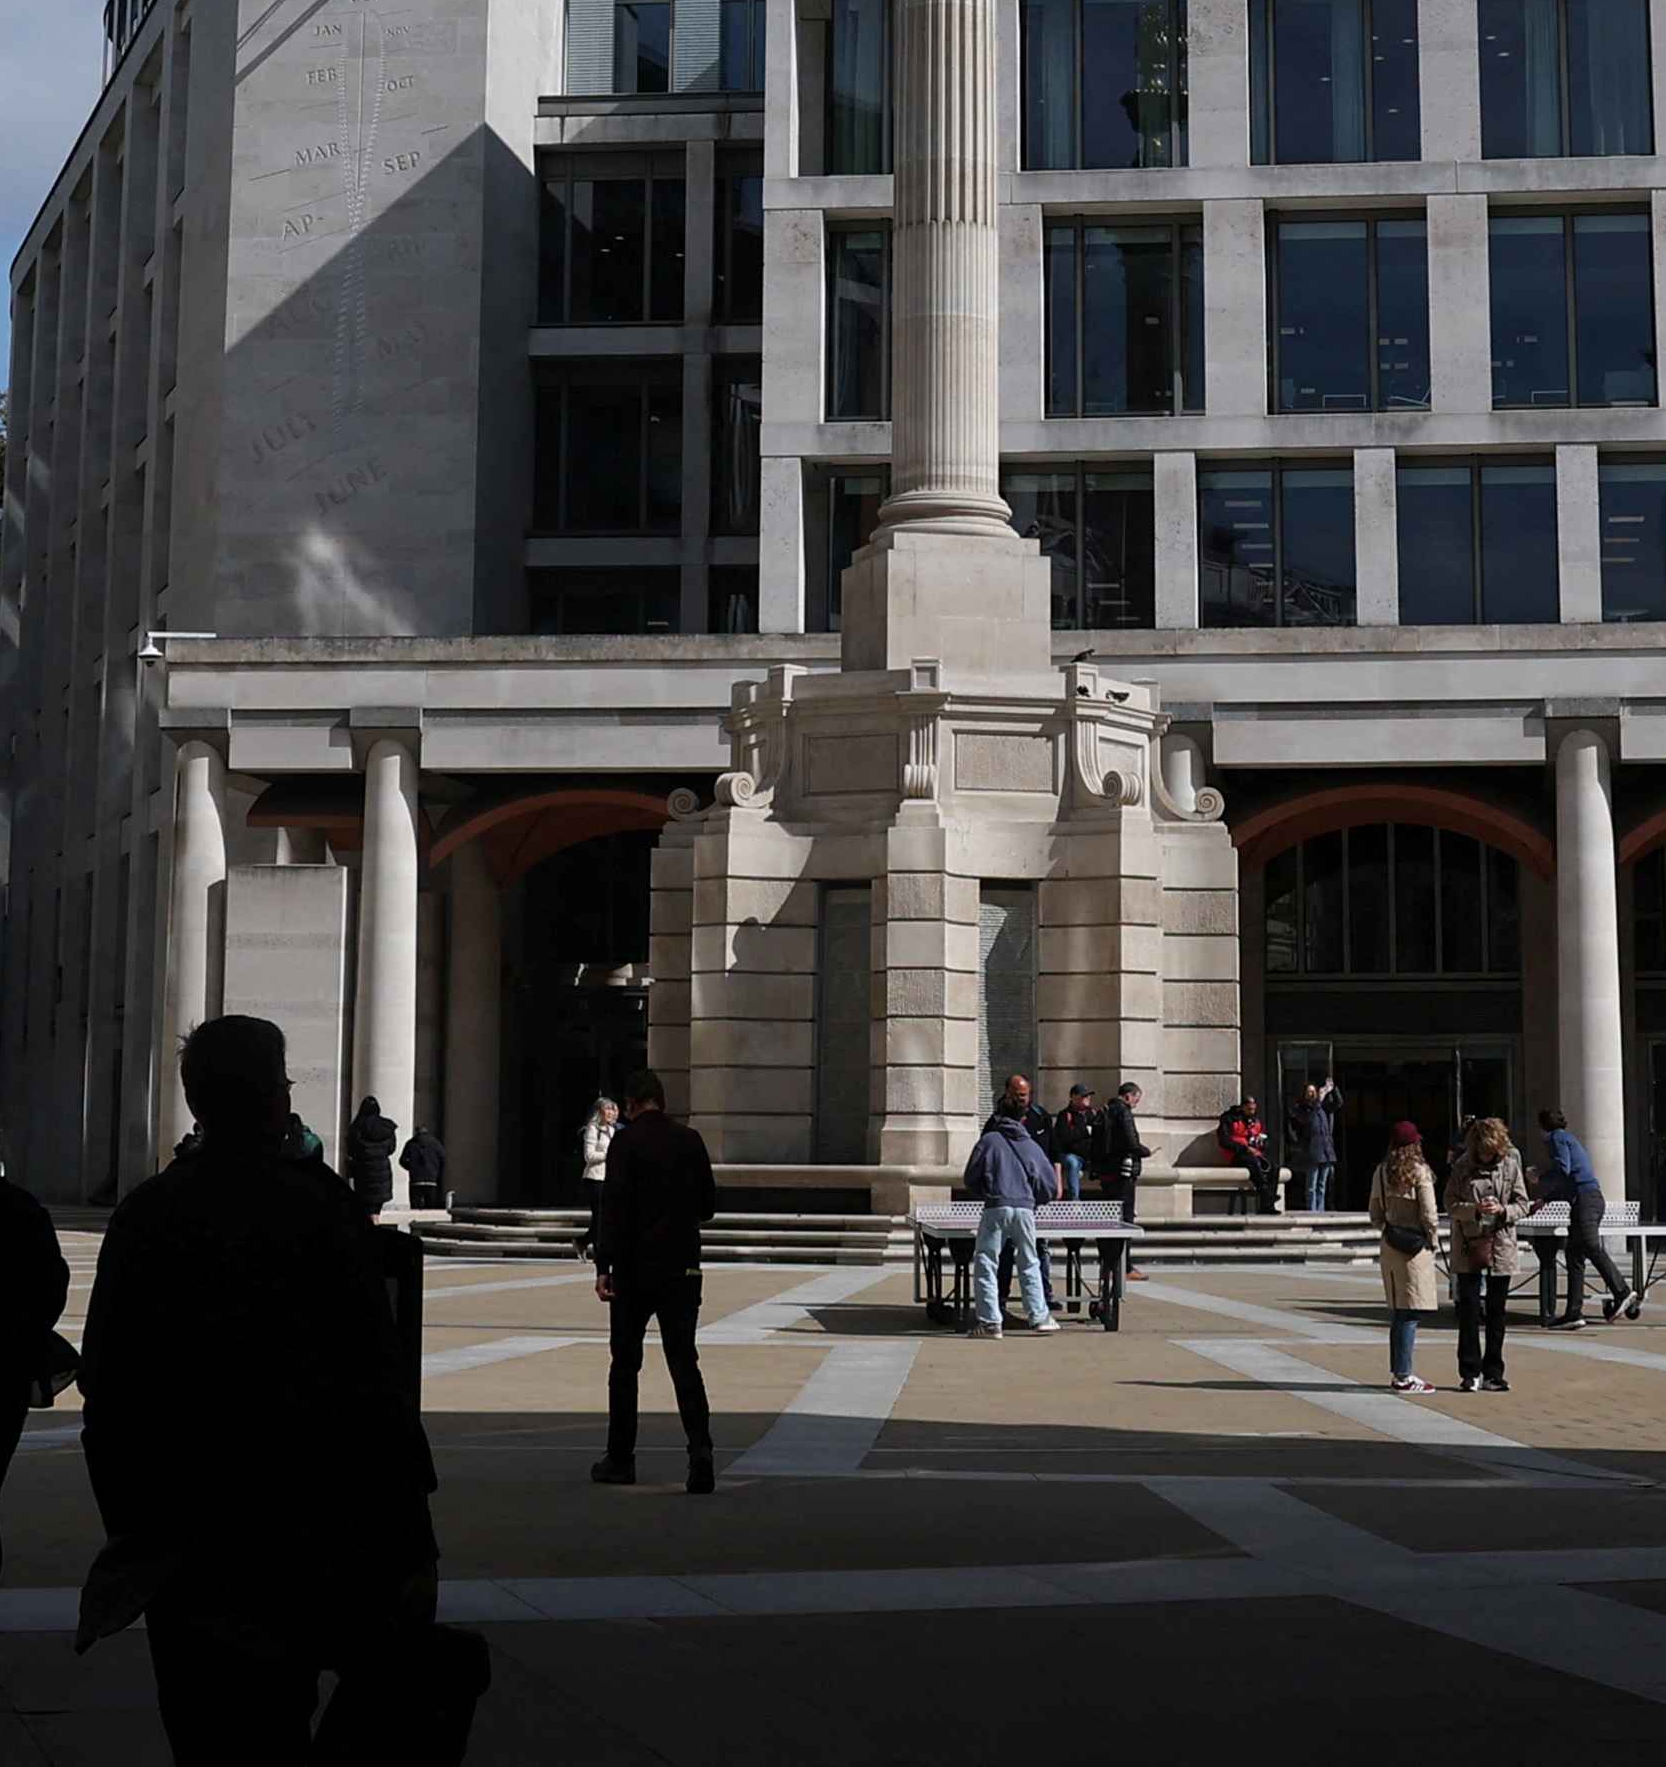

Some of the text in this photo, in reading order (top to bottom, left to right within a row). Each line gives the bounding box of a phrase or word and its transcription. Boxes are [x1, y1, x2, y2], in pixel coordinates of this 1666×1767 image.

[315, 24, 343, 37] JAN
[385, 26, 412, 39] NOV
[306, 68, 338, 85] FEB
[386, 75, 415, 93] OCT
[295, 142, 341, 166] MAR
[382, 150, 422, 176] SEP
[314, 455, 388, 515] JUNE
